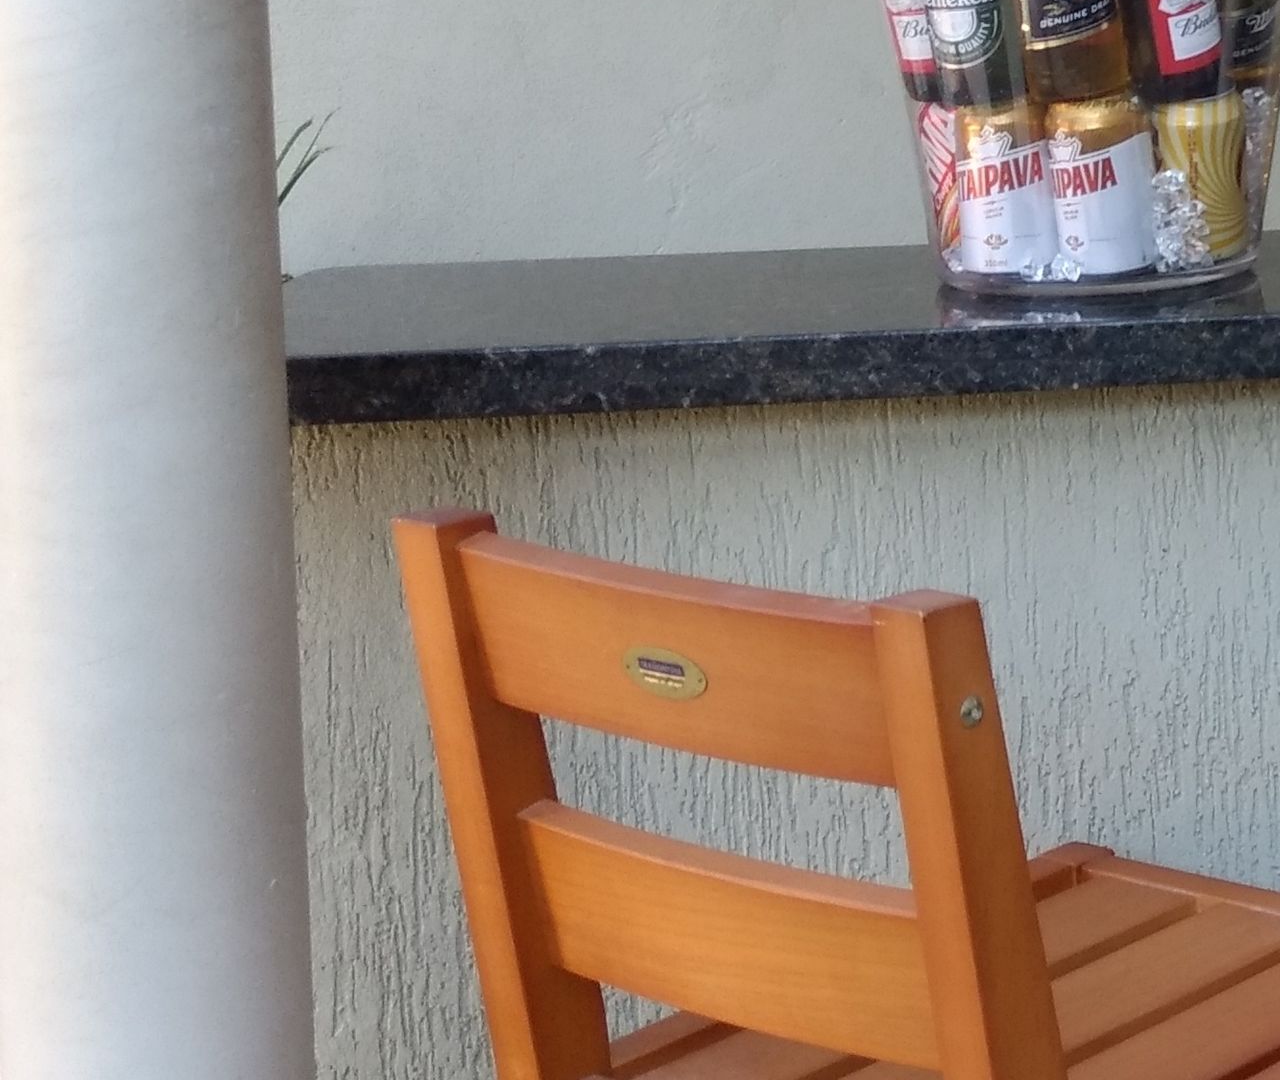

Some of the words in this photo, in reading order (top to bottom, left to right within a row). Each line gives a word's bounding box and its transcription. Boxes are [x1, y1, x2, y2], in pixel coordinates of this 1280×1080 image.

[1040, 9, 1088, 29] GENUINE
[957, 22, 990, 54] QUALITY
[957, 150, 1043, 202] TAIPAVA
